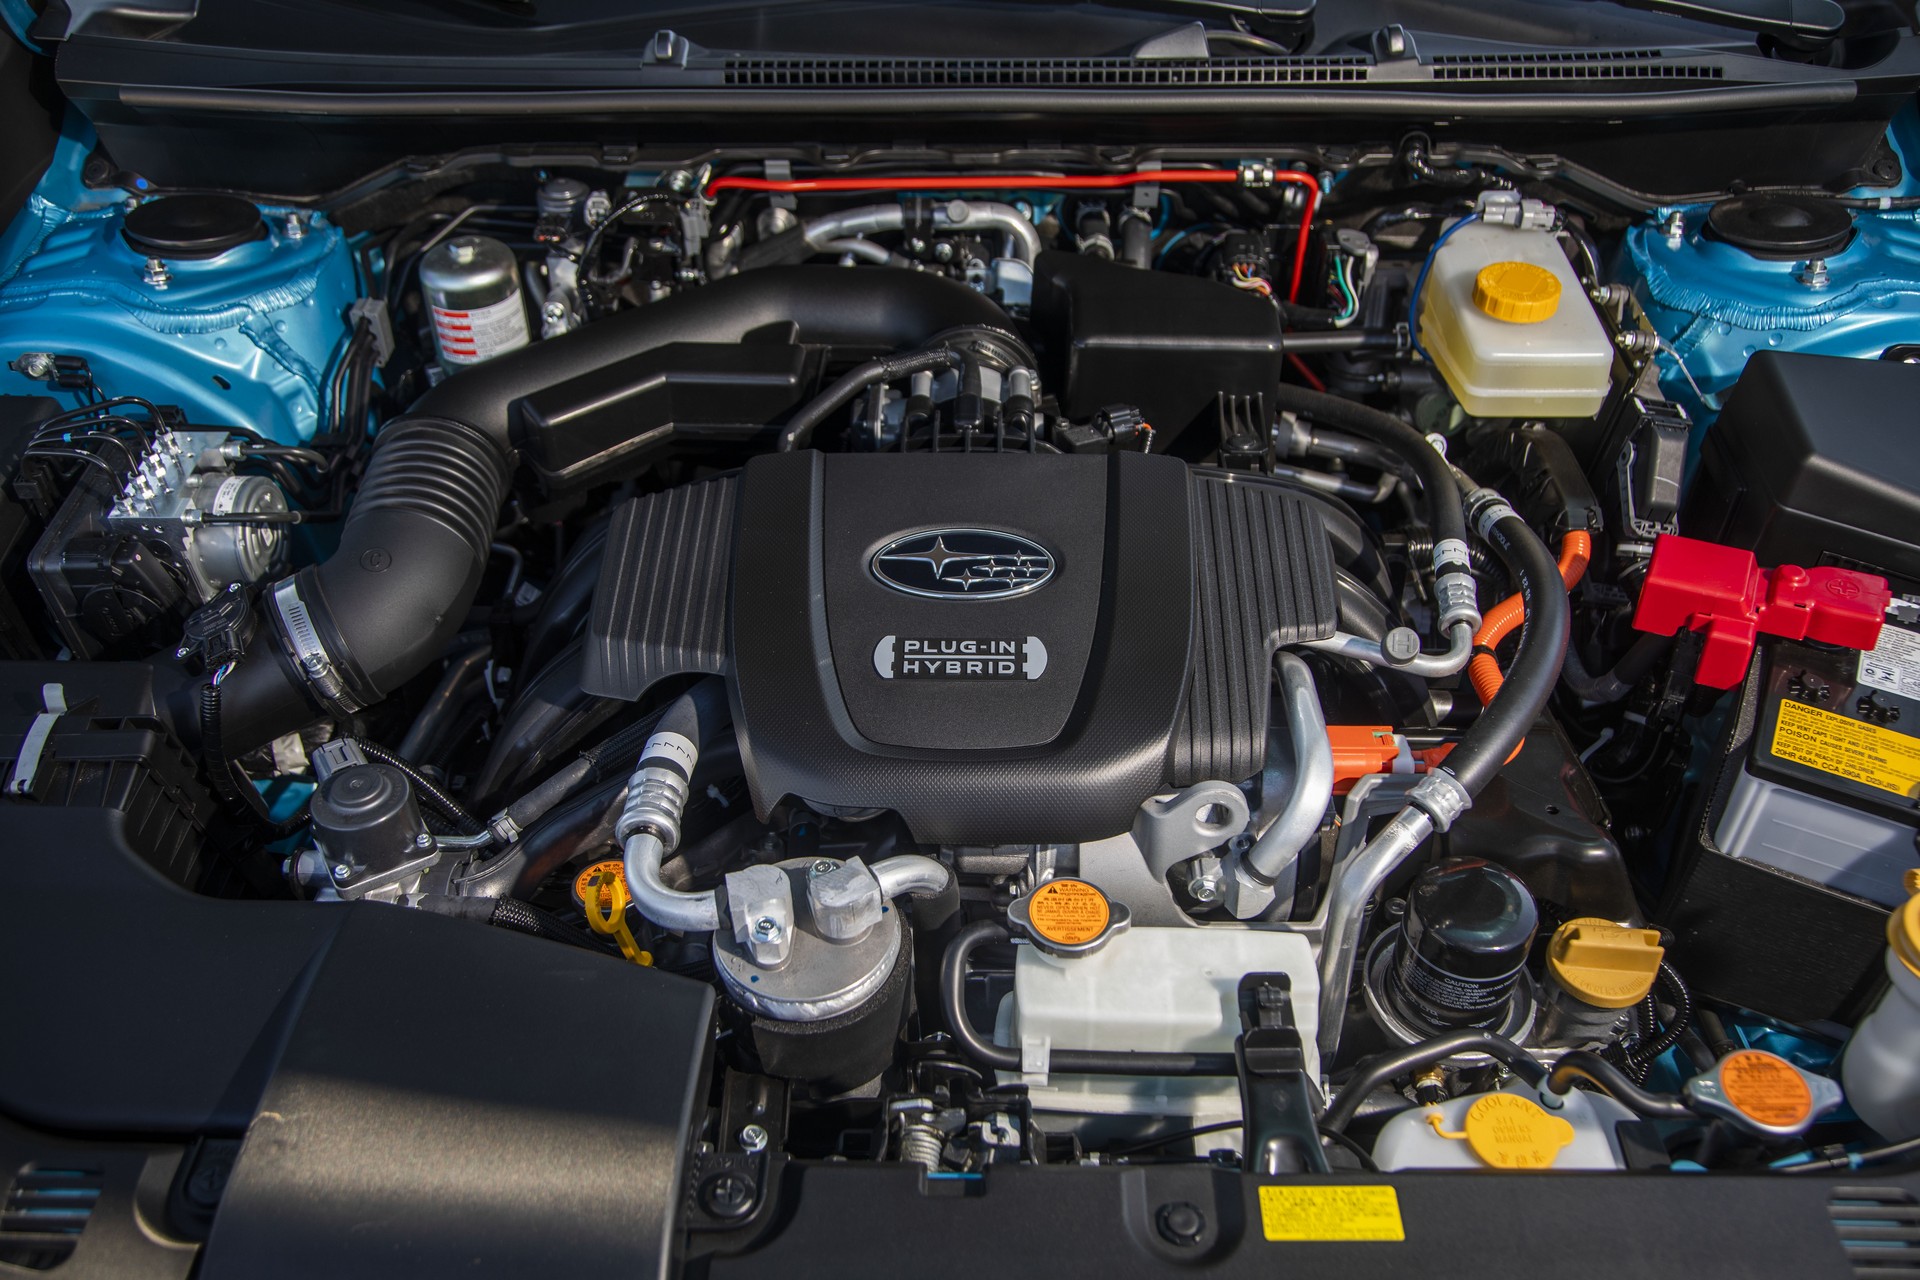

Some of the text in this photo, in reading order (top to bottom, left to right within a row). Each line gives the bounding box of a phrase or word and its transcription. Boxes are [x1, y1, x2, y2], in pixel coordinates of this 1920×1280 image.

[904, 640, 1016, 654] PLUG-IN
[1392, 633, 1413, 653] H
[903, 661, 1016, 674] HYBRID
[1784, 701, 1876, 733] DANGER EXPLOSIVE GASES
[1778, 726, 1817, 742] POISON
[1819, 739, 1842, 750] CAUSES
[1844, 747, 1865, 756] SEVERE
[1780, 720, 1797, 728] KEEP
[1796, 724, 1811, 732] VENT
[1812, 729, 1827, 737] CAPS
[1829, 734, 1845, 743] TIGHT
[1861, 744, 1879, 753] LEVEL
[1775, 747, 1796, 758] 20HR
[1821, 761, 1840, 772] CCA
[1841, 768, 1861, 779] 390A
[1776, 741, 1791, 749] KEEP
[1814, 753, 1834, 762] REACH
[1844, 762, 1875, 774] CHILDREN
[1444, 977, 1479, 989] CAUTION
